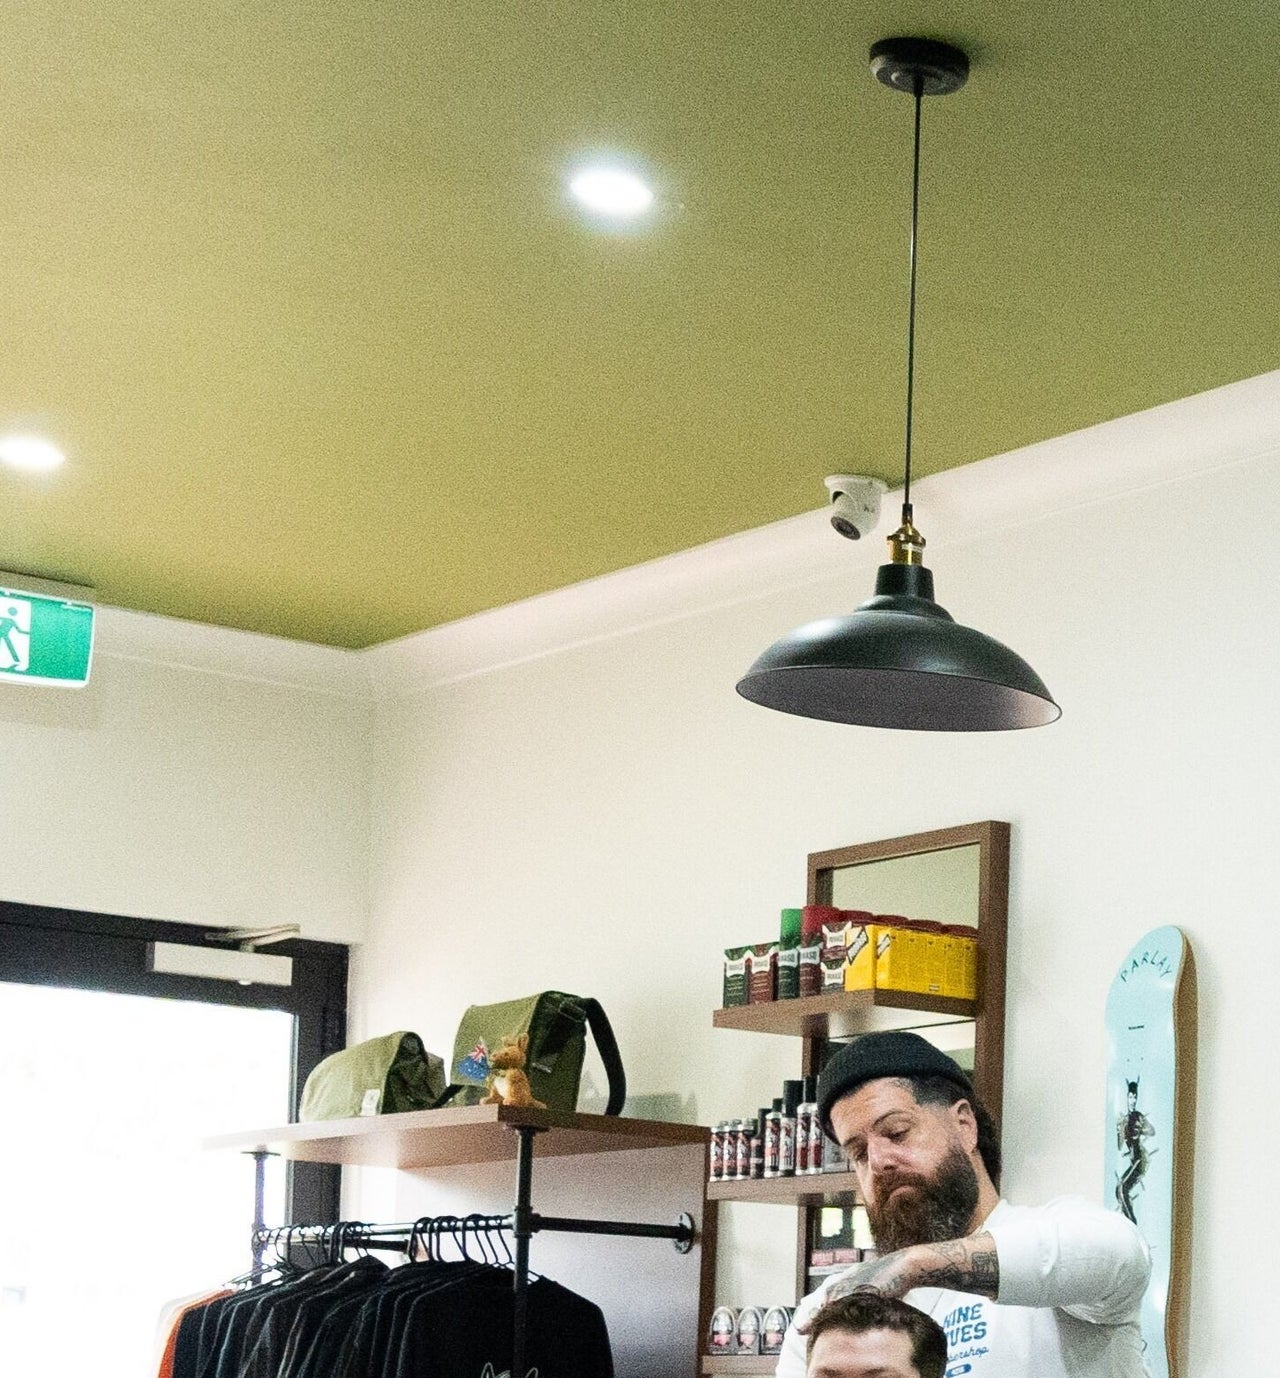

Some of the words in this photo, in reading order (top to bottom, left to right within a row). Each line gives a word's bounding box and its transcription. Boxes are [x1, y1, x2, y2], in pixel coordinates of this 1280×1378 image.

[1121, 950, 1172, 982] PARLAY
[943, 1303, 983, 1328] NINE
[947, 1322, 987, 1346] VES
